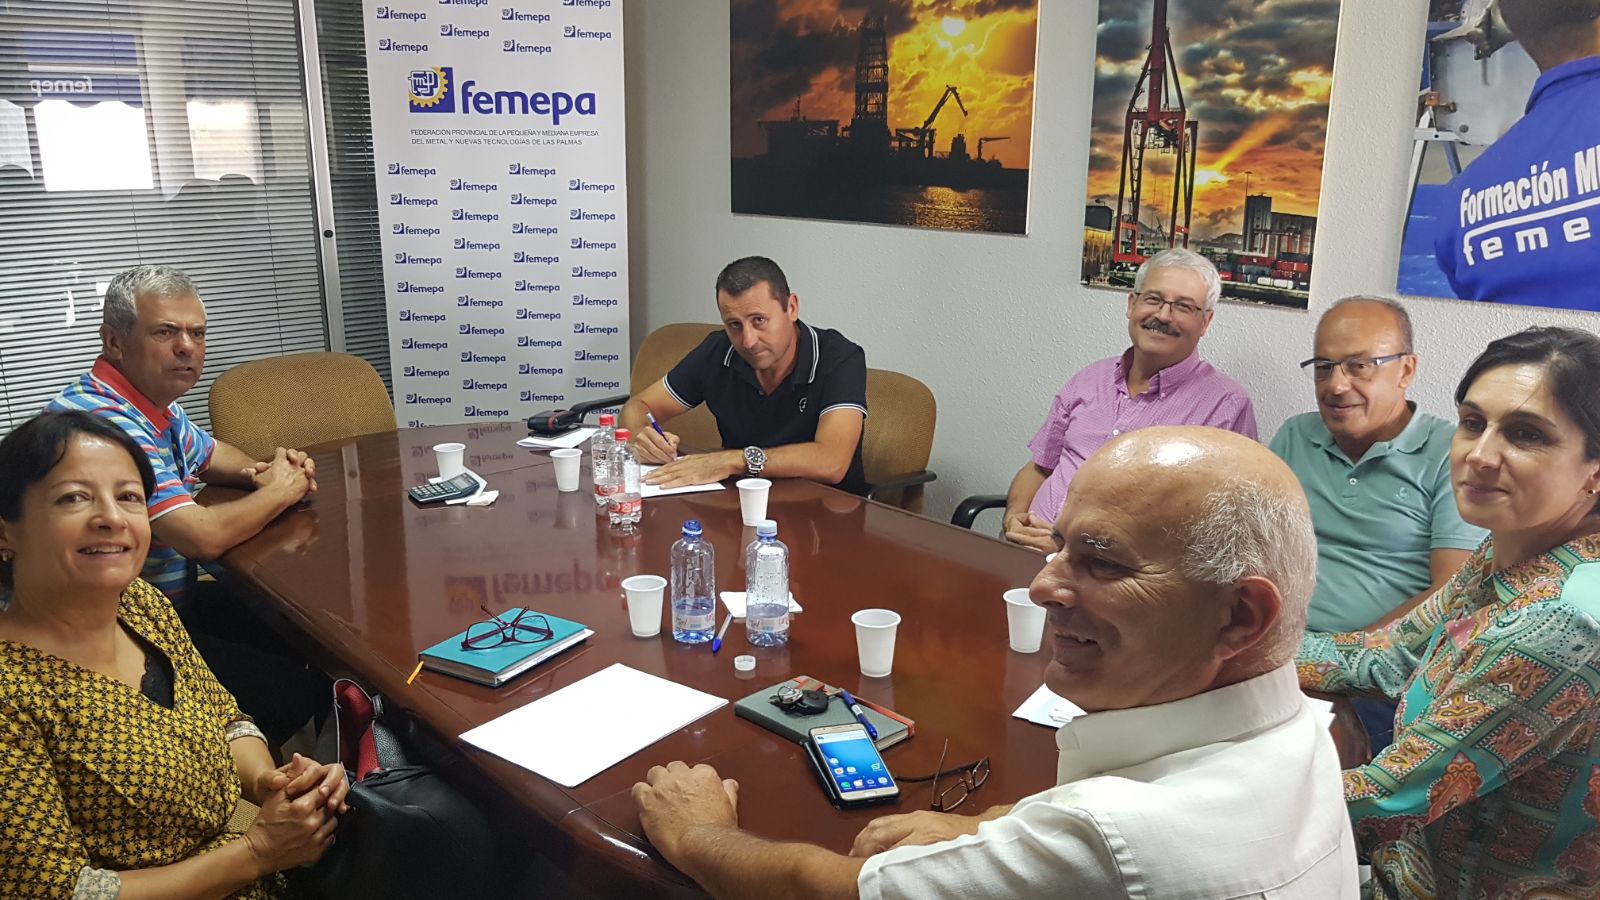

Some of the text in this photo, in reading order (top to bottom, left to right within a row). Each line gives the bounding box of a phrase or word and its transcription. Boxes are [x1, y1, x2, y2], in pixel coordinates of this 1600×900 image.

[576, 0, 610, 9] femepa
[390, 10, 426, 22] femepa
[515, 12, 550, 24] femepa
[454, 27, 489, 39] femepa
[577, 29, 611, 41] femepa
[393, 42, 428, 54] femepa
[517, 43, 551, 55] femepa
[461, 80, 596, 126] femepa
[542, 129, 569, 137] MEDIANA
[570, 129, 599, 137] EMPRESA
[401, 166, 436, 178] femepa
[522, 166, 556, 178] femepa
[463, 182, 497, 193] femepa
[582, 182, 615, 193] femepa
[1460, 160, 1568, 228] Formación
[403, 197, 438, 208] femepa
[524, 196, 557, 207] femepa
[465, 212, 499, 223] femepa
[582, 212, 615, 222] femepa
[406, 226, 440, 237] femepa
[525, 225, 558, 236] femepa
[467, 241, 500, 252] femepa
[583, 240, 616, 251] femepa
[408, 256, 442, 266] femepa
[526, 255, 559, 265] femepa
[468, 270, 502, 280] femepa
[584, 269, 617, 279] femepa
[410, 284, 444, 295] femepa
[527, 283, 560, 293] femepa
[470, 298, 503, 309] femepa
[585, 297, 617, 308] femepa
[412, 313, 446, 323] femepa
[528, 311, 561, 321] femepa
[472, 327, 504, 336] femepa
[586, 325, 618, 336] femepa
[414, 341, 447, 351] femepa
[530, 339, 562, 349] femepa
[473, 354, 506, 364] femepa
[587, 353, 618, 363] femepa
[416, 369, 449, 379] femepa
[531, 366, 563, 376] femepa
[475, 381, 507, 391] femepa
[587, 380, 619, 390] femepa
[418, 396, 451, 406] femepa
[532, 393, 564, 403] femepa
[477, 409, 508, 418] femepa
